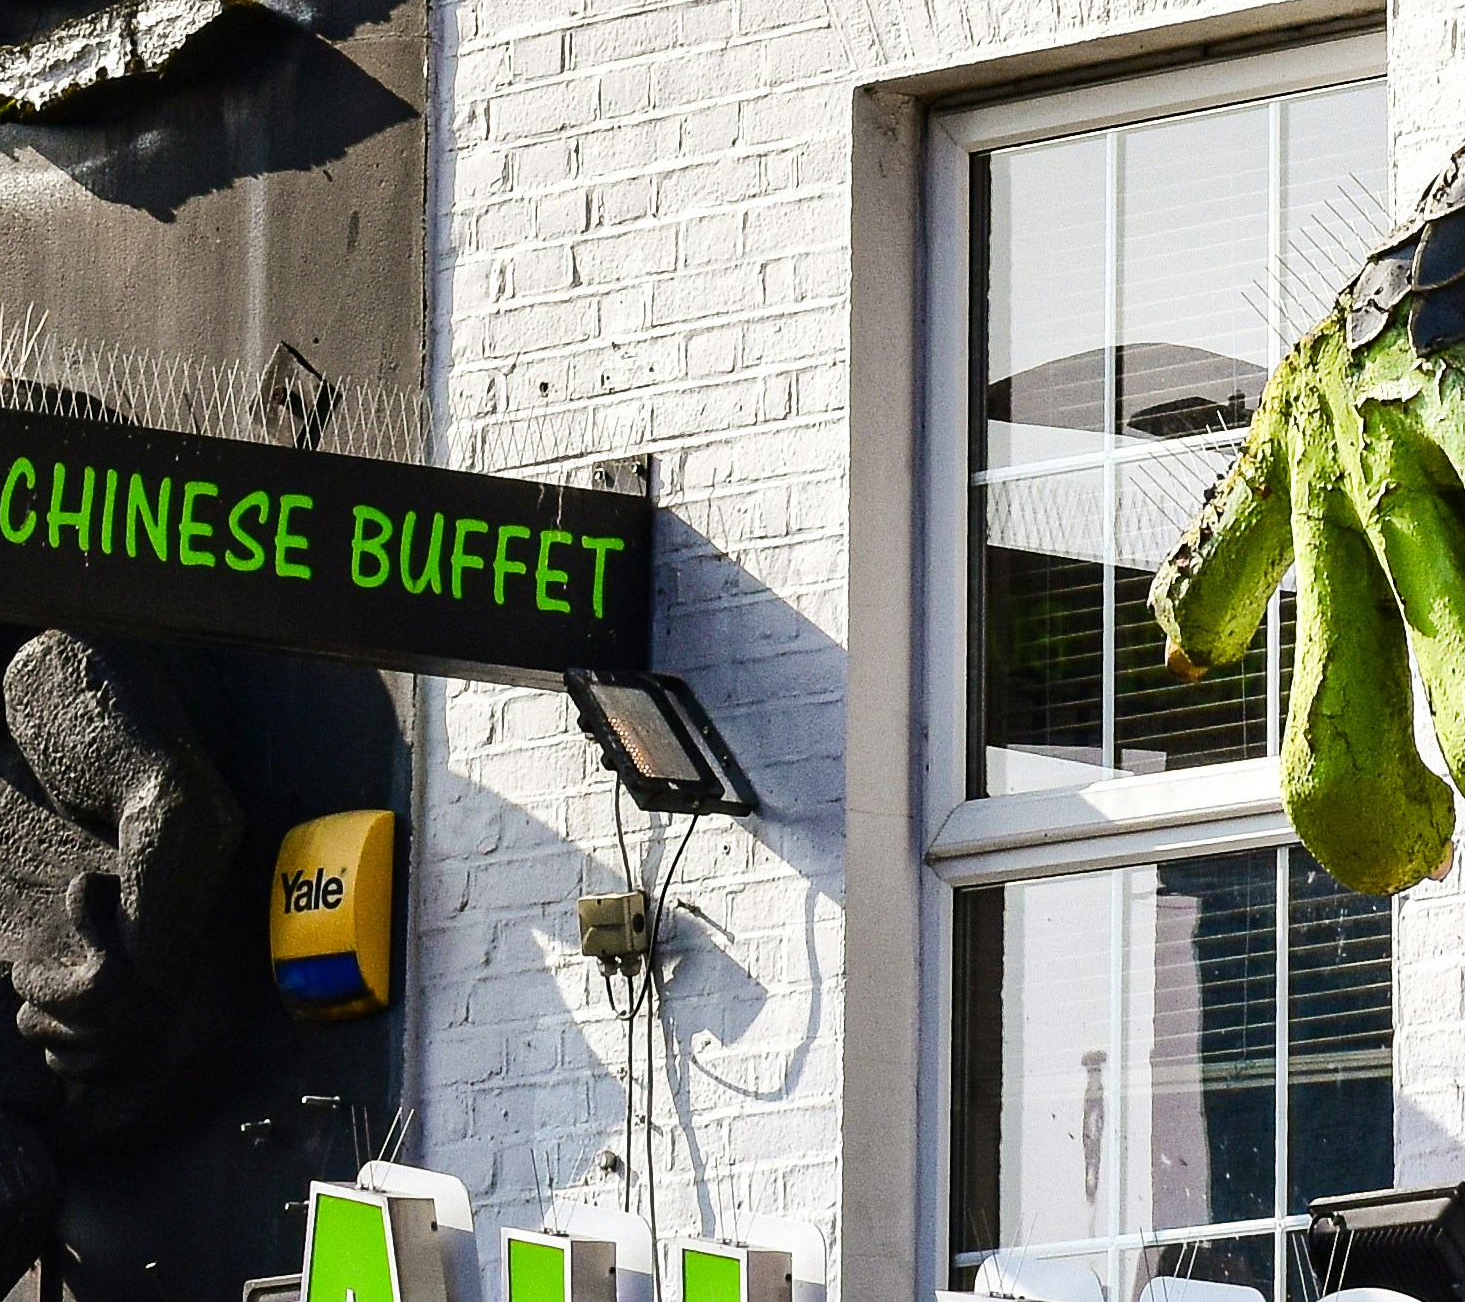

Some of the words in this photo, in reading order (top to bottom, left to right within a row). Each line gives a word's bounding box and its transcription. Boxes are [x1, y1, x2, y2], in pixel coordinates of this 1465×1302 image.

[0, 457, 313, 580] CHINESE
[351, 505, 625, 619] BUFFET
[281, 868, 344, 914] Yale
